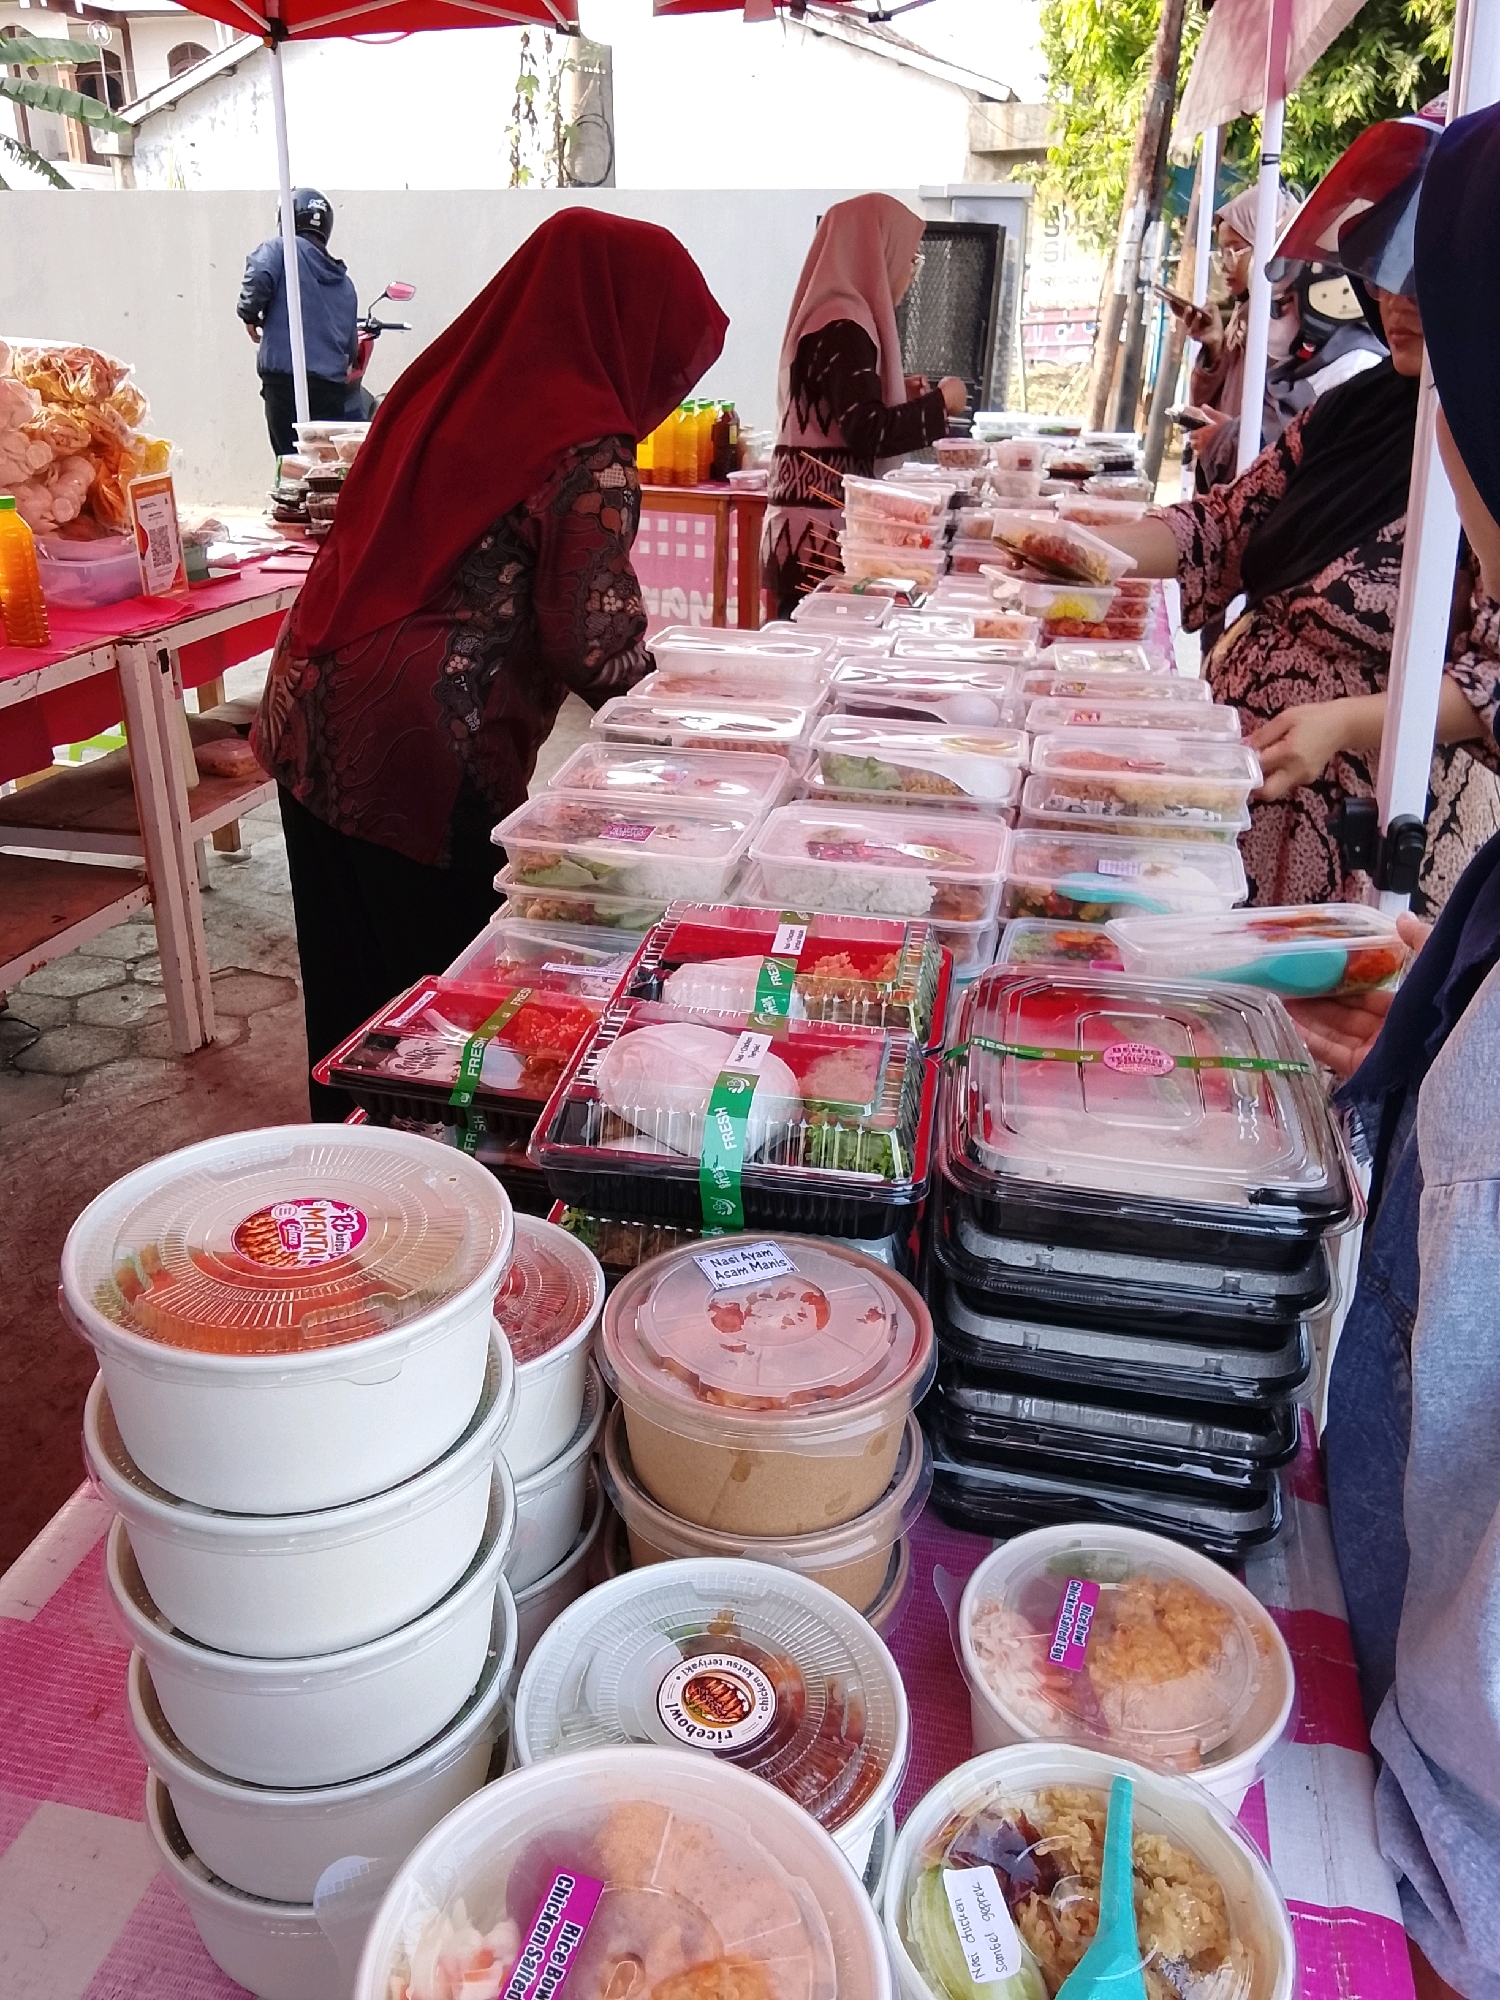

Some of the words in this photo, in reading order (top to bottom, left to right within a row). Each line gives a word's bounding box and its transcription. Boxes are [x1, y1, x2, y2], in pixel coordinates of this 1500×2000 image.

[765, 962, 783, 986] FRESH
[510, 987, 532, 1006] FRES
[467, 1036, 489, 1077] FRESH
[973, 1037, 1019, 1053] RESH
[714, 1106, 738, 1150] FRESH
[300, 1206, 328, 1259] MENTAI
[328, 1212, 357, 1233] RB
[710, 1254, 740, 1268] Nasi
[740, 1249, 774, 1262] Ayam
[714, 1266, 749, 1280] Asam
[749, 1258, 787, 1273] Manis
[1062, 1580, 1082, 1614] Chicken
[1077, 1603, 1093, 1624] Rice
[1056, 1614, 1073, 1643] Salted
[1072, 1624, 1088, 1646] Bowl
[1050, 1642, 1067, 1661] Egg
[681, 1659, 723, 1677] teriyaki
[726, 1660, 754, 1679] katsu
[753, 1676, 769, 1712] chicken
[664, 1702, 733, 1744] ricebowl
[530, 1874, 575, 1947] Chicken
[972, 1882, 996, 1922] geprek
[550, 1921, 582, 1965] Rice
[967, 1952, 985, 1979] Nasi
[531, 1963, 565, 2000] Bow
